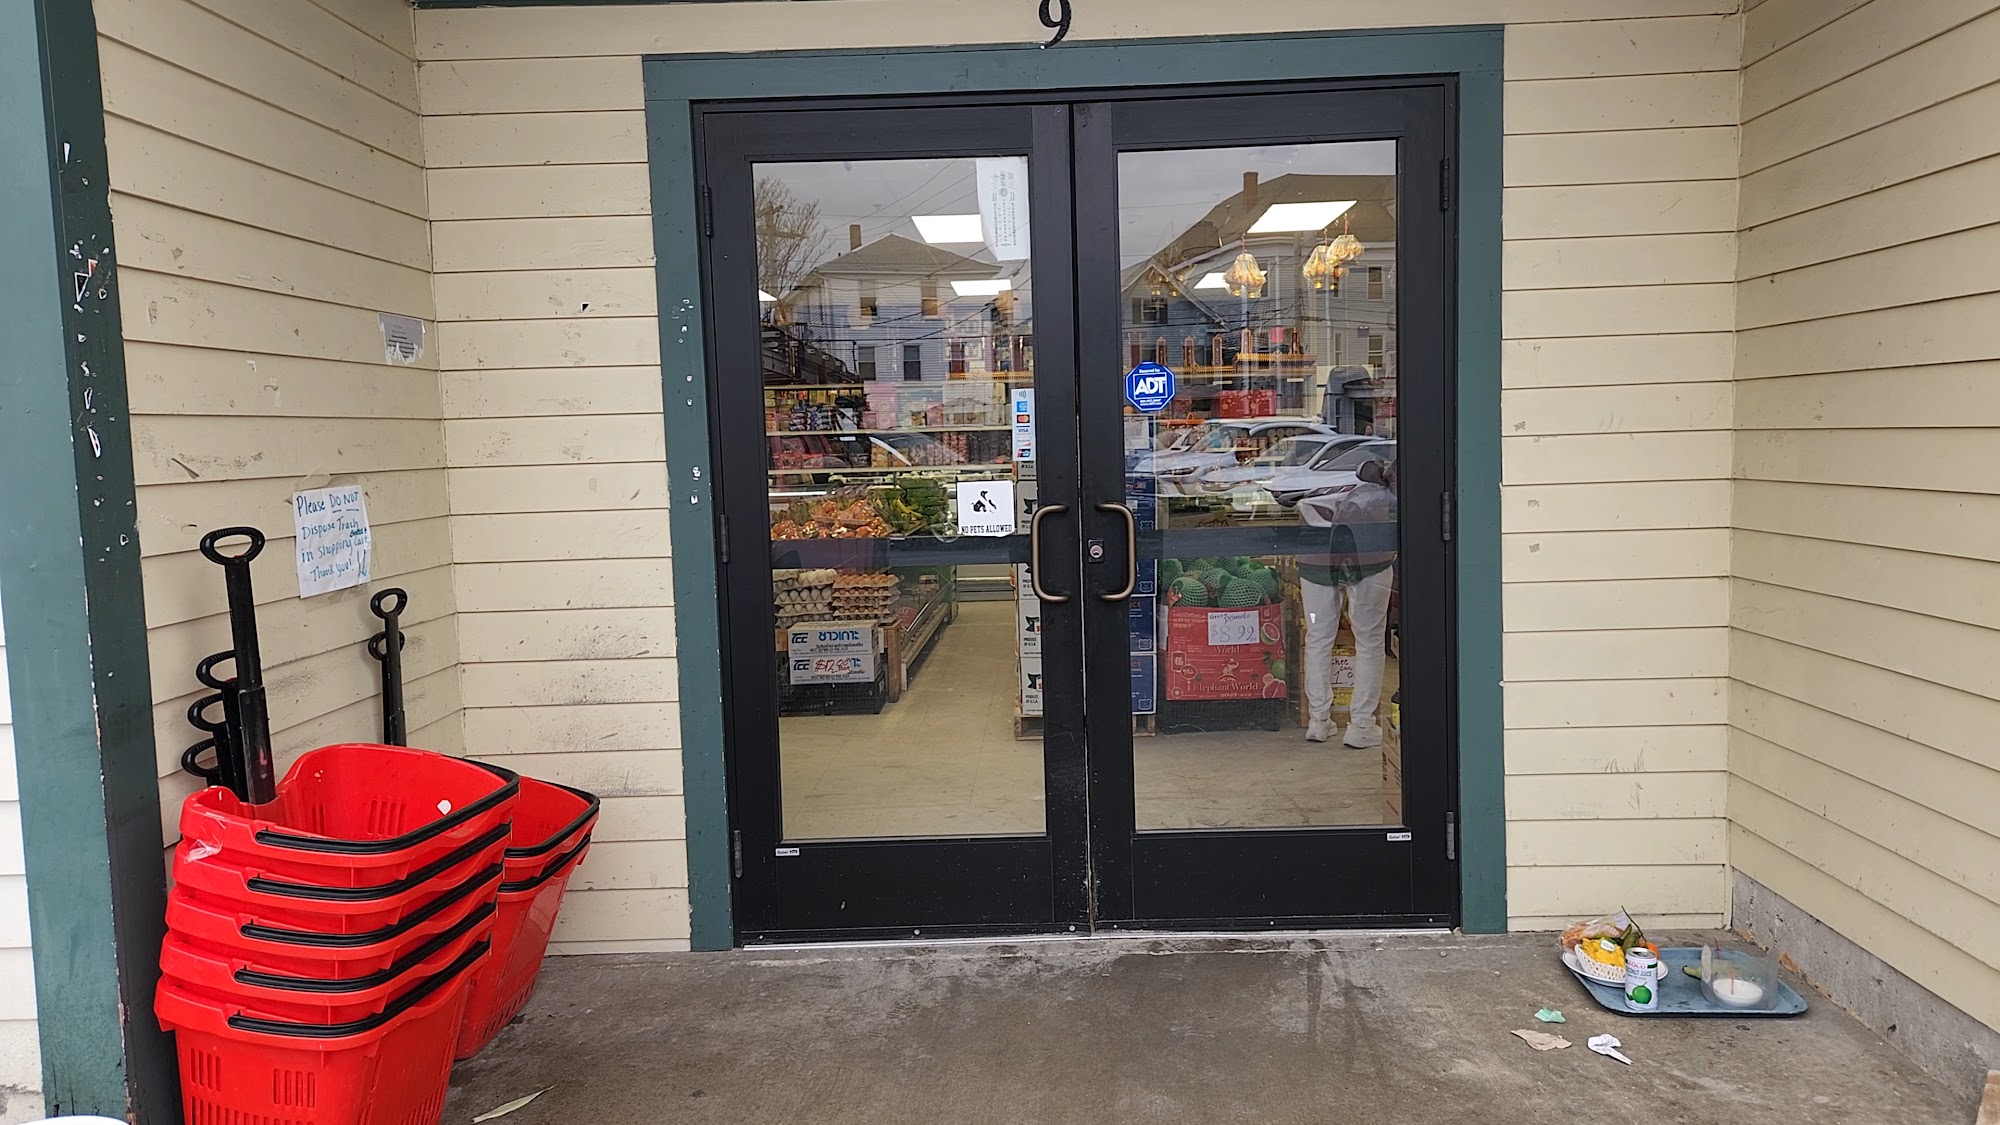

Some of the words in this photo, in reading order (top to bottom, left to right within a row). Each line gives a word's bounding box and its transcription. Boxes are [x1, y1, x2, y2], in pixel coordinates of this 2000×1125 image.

[1039, 0, 1071, 48] 9
[1135, 377, 1166, 395] ADT
[297, 496, 325, 517] Please
[329, 494, 341, 507] DO
[343, 492, 358, 504] NOT
[301, 524, 335, 539] Dispose
[337, 516, 358, 531] Trash
[986, 525, 1012, 533] ALLOWED
[302, 549, 313, 562] in
[310, 566, 334, 581] Thank
[792, 632, 808, 643] TCC
[1215, 645, 1239, 653] World
[793, 659, 810, 670] TCC
[1193, 684, 1229, 693] Elephant
[1232, 683, 1258, 691] World
